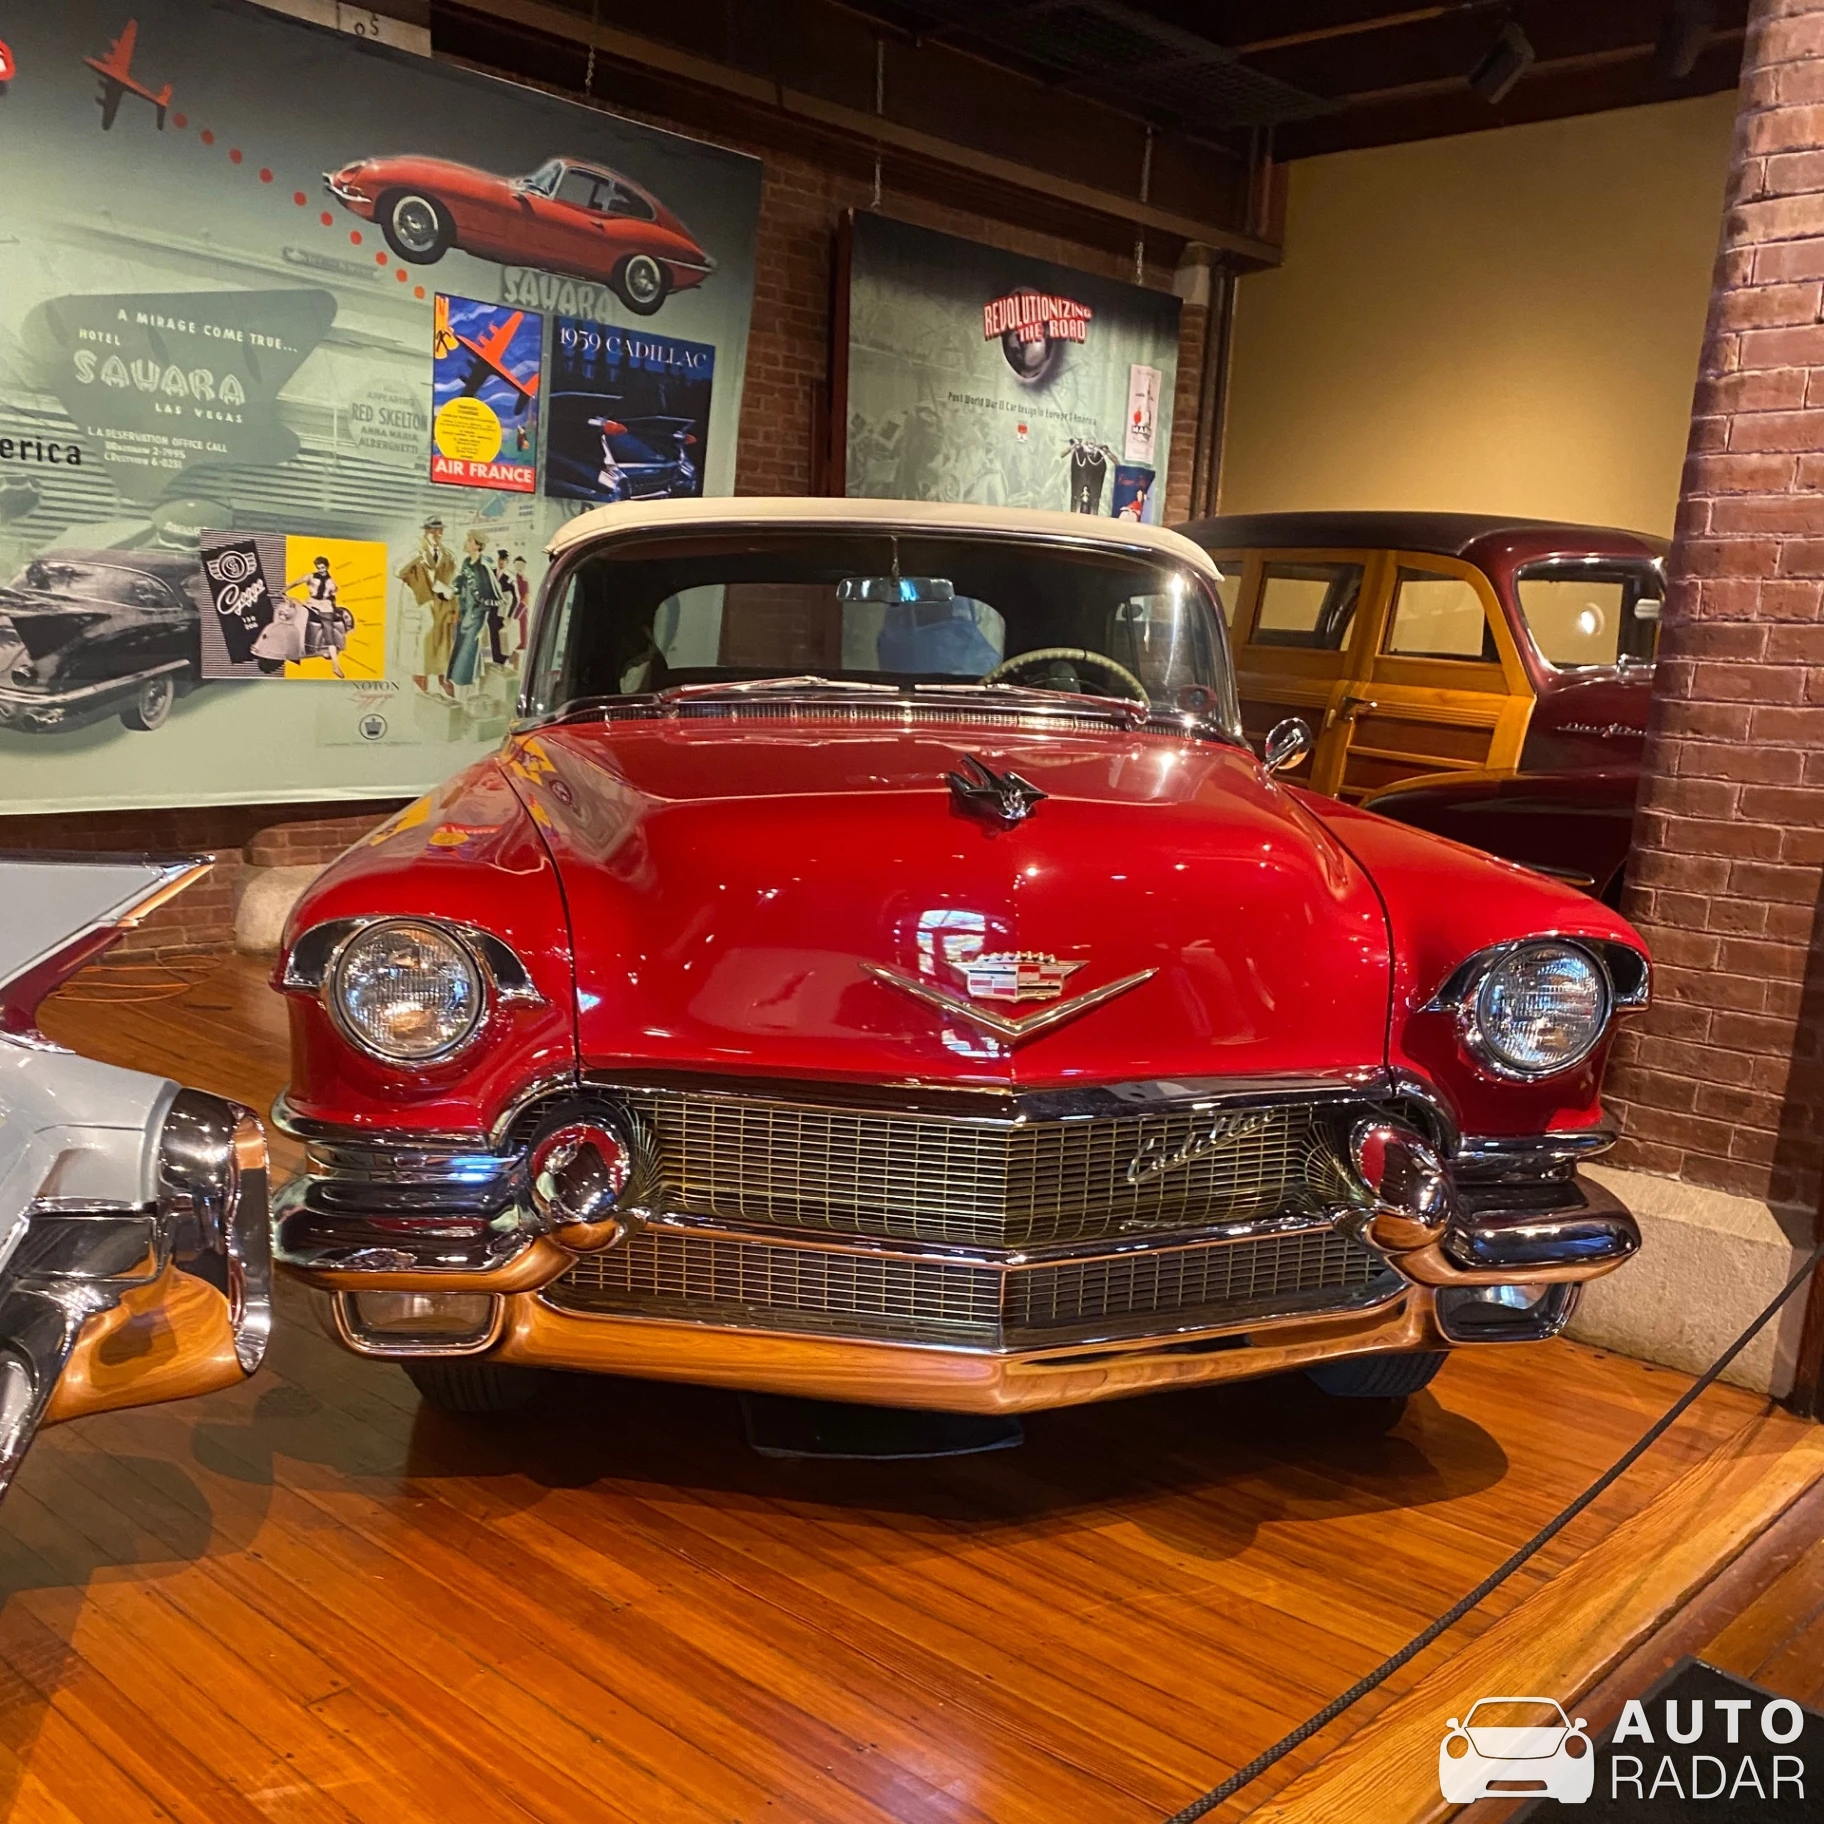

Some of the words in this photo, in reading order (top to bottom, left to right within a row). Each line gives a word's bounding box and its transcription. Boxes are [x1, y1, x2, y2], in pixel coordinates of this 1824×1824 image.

[984, 293, 1092, 337] REVOLUTIONIZING
[79, 328, 121, 346] HOTEL
[117, 309, 128, 321] A
[136, 312, 196, 334] MIRAGE
[203, 325, 243, 342] COME
[250, 333, 298, 352] TRUE...
[1020, 322, 1043, 342] THE
[1049, 319, 1087, 340] ROAD
[559, 327, 601, 351] 1959
[606, 336, 707, 369] CADILLAC
[155, 402, 182, 415] LAS
[194, 408, 243, 423] VEGAS
[352, 402, 374, 422] RED
[379, 407, 428, 432] SKELTON
[1006, 401, 1017, 412] Car
[0, 435, 81, 465] erica
[172, 437, 203, 450] OFFICE
[205, 442, 228, 453] CALL
[435, 459, 464, 475] AIR
[469, 463, 532, 483] FRANCE
[1127, 1108, 1275, 1183] Cadillac
